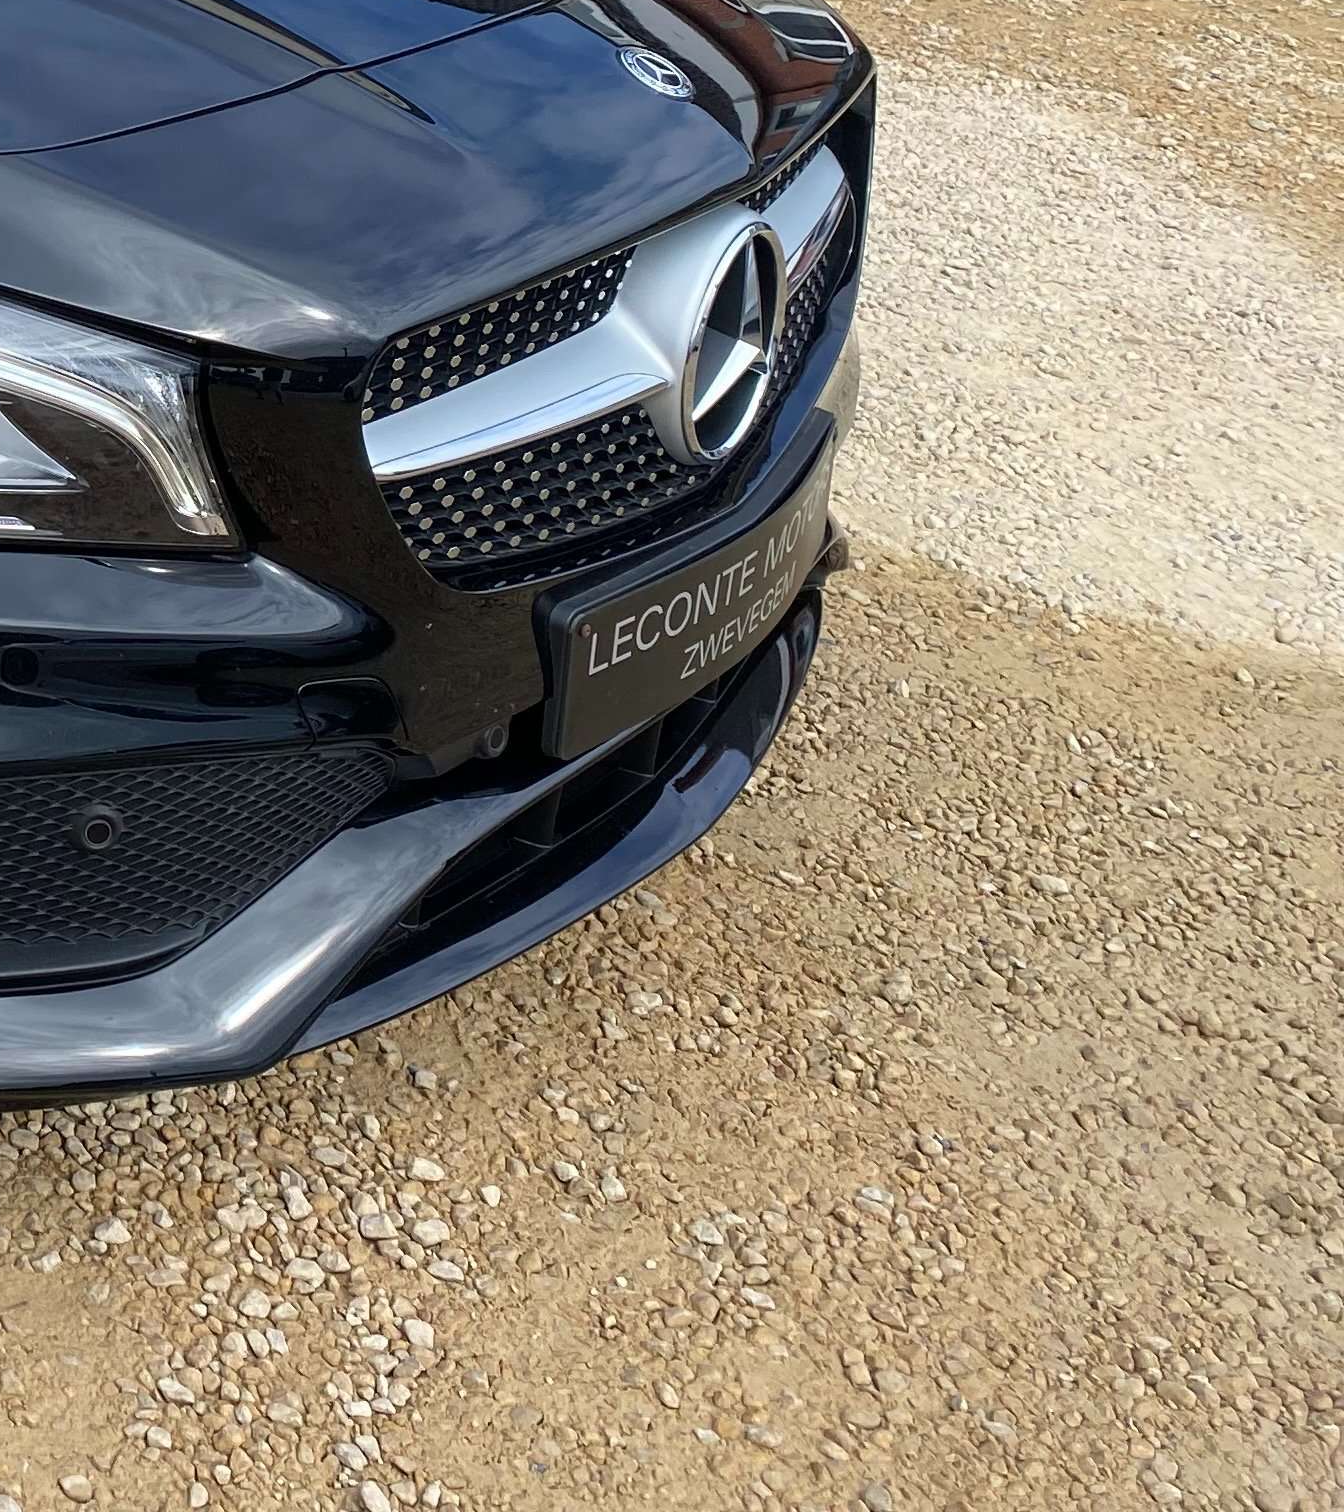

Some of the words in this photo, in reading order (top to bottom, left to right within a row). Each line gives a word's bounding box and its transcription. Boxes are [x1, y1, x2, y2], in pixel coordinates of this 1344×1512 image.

[588, 550, 760, 677] LECONTE
[763, 478, 828, 579] MOTO
[680, 560, 797, 680] ZWEVEGEN
